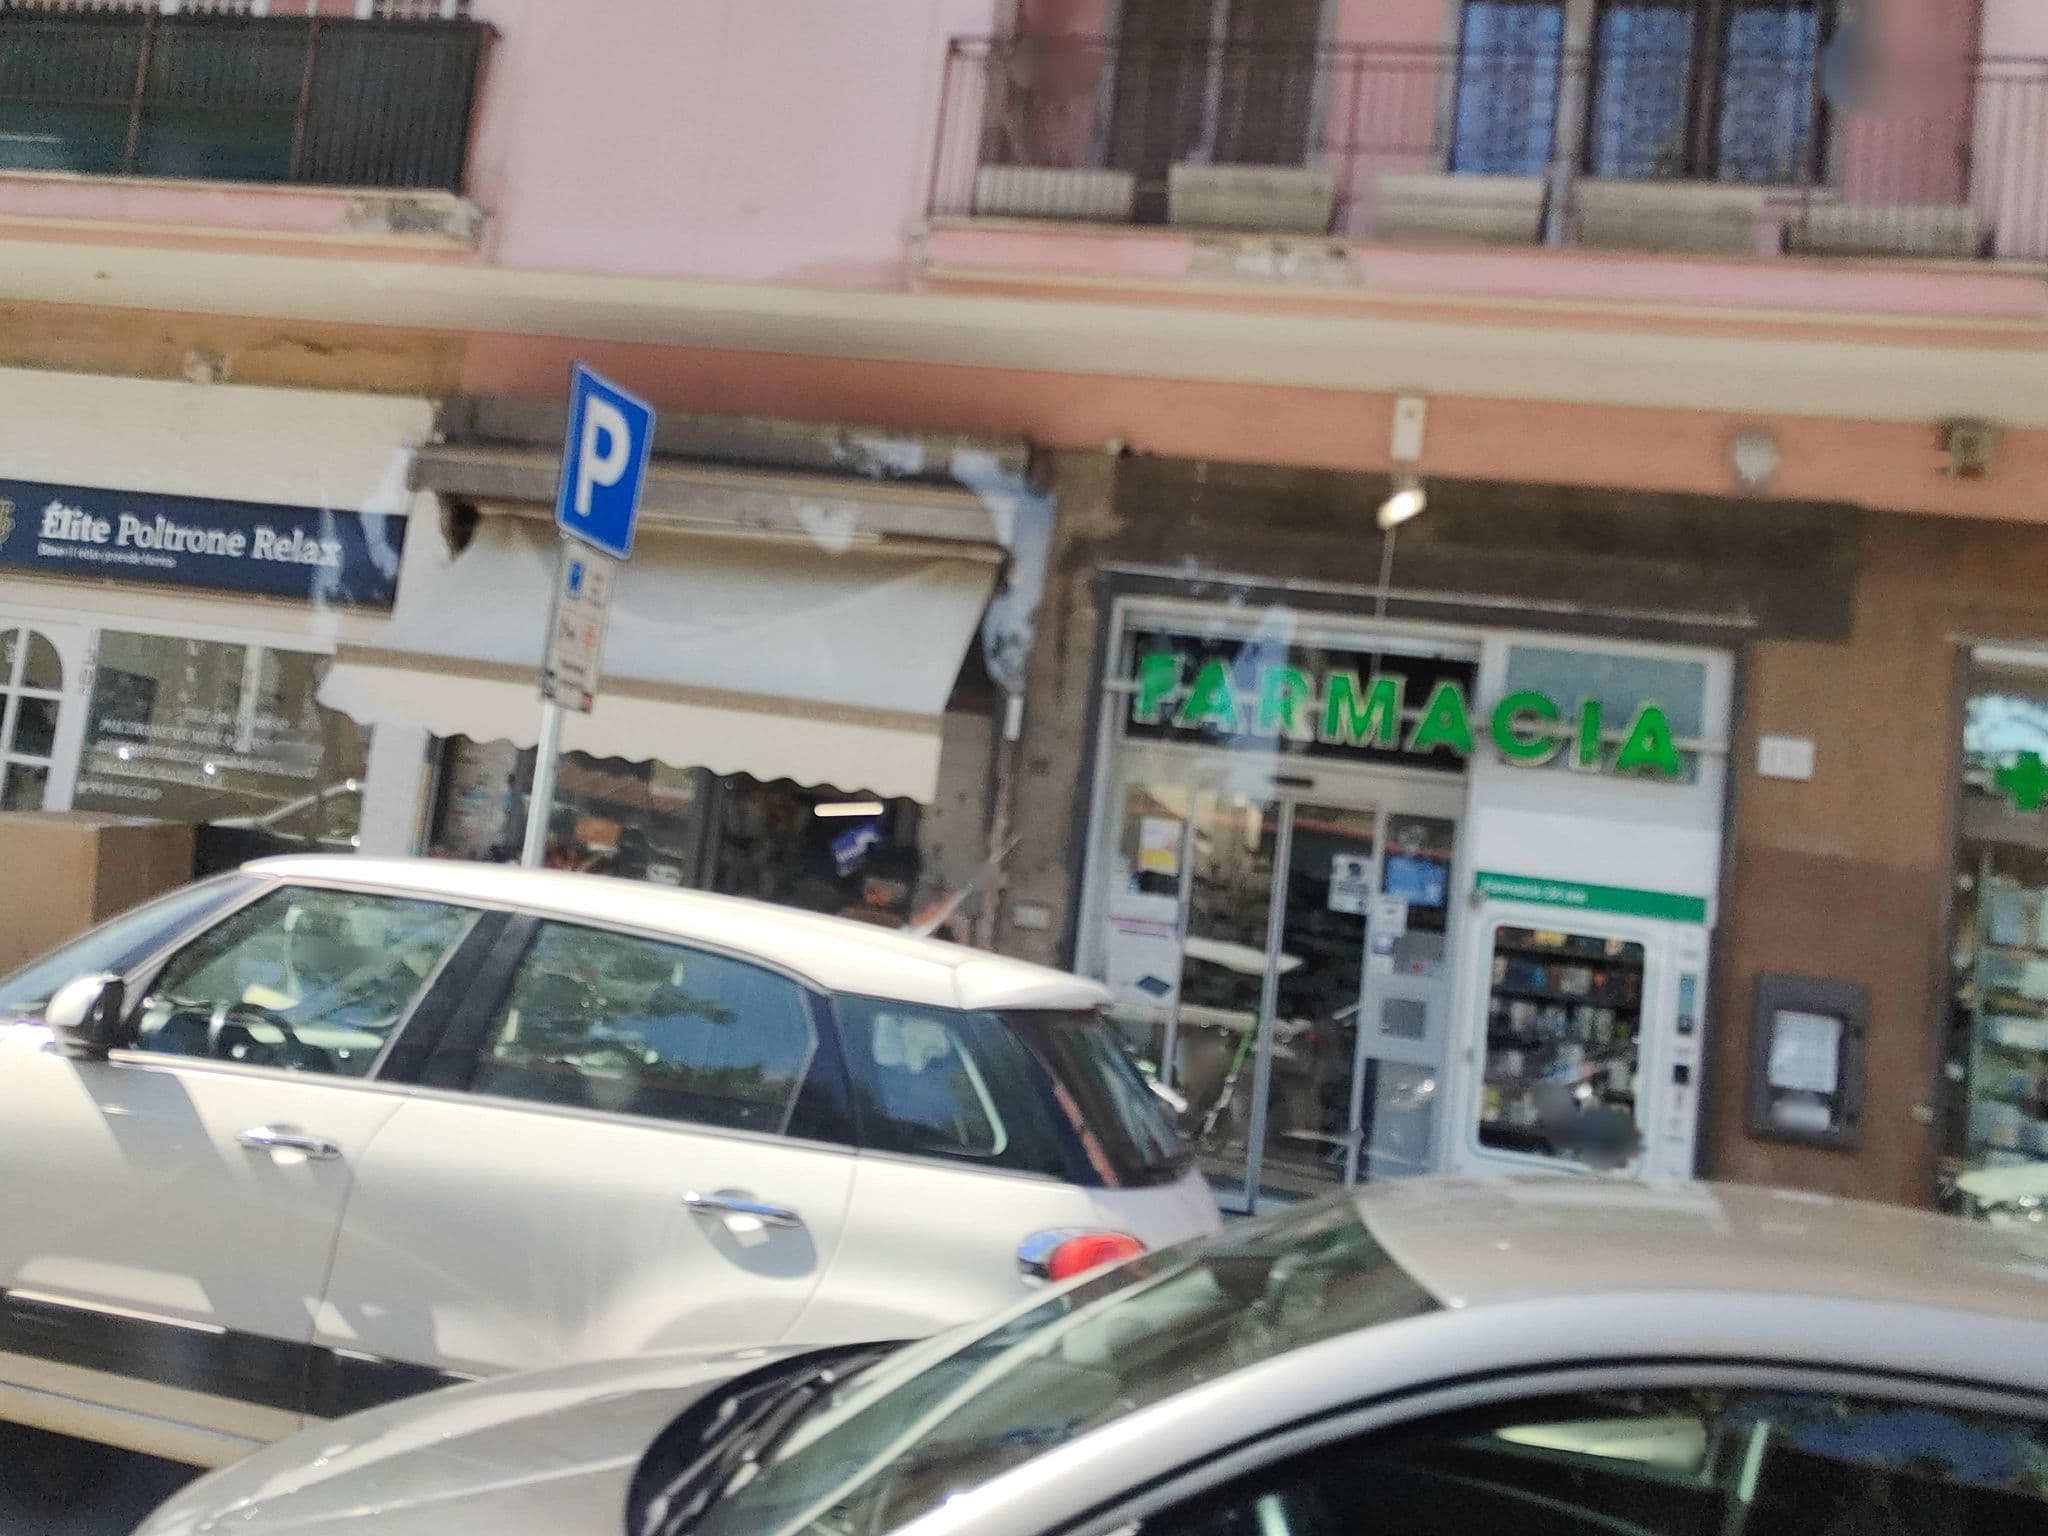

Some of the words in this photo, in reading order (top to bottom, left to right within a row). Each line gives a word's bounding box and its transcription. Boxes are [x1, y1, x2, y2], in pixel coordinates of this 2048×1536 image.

[573, 392, 632, 518] P
[117, 512, 246, 558] Poltrone
[252, 524, 344, 567] Relax
[1133, 652, 1682, 777] FARMACIA
